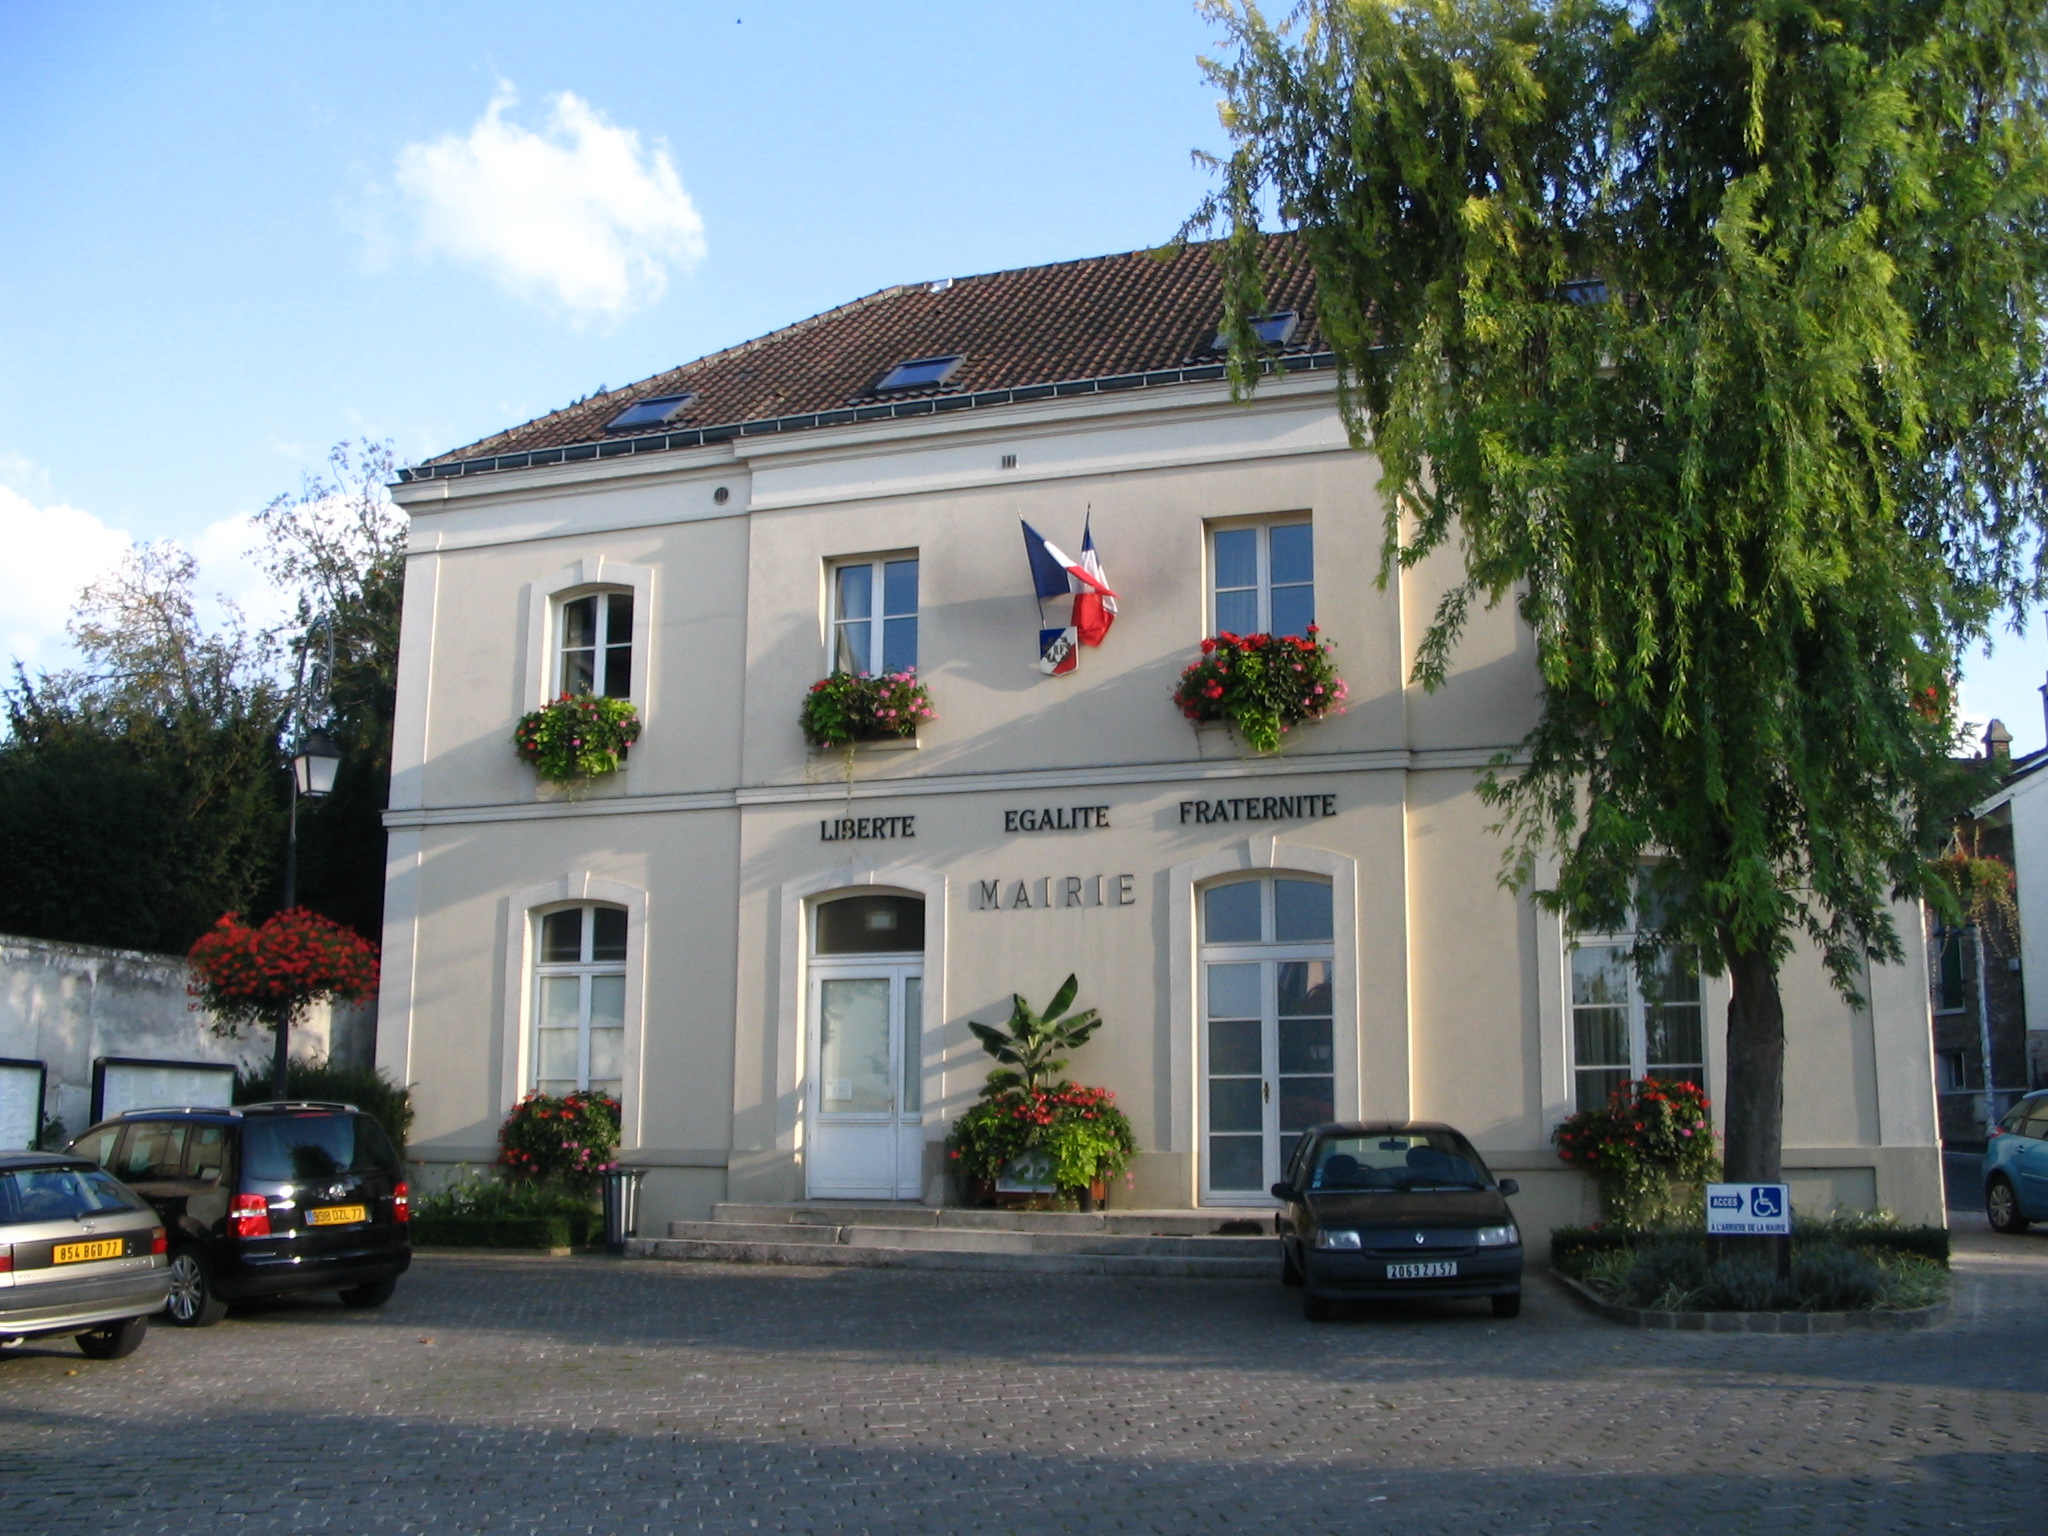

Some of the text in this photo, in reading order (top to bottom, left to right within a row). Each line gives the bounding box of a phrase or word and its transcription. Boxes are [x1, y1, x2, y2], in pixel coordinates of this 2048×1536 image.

[820, 794, 1337, 842] LIBERTE EGALITE FRATERNITE
[980, 873, 1136, 911] MAIRIE
[351, 1208, 362, 1219] 77
[60, 1247, 80, 1260] 854
[106, 1242, 117, 1256] 77
[1391, 1263, 1453, 1277] 2069 ZJ 57
